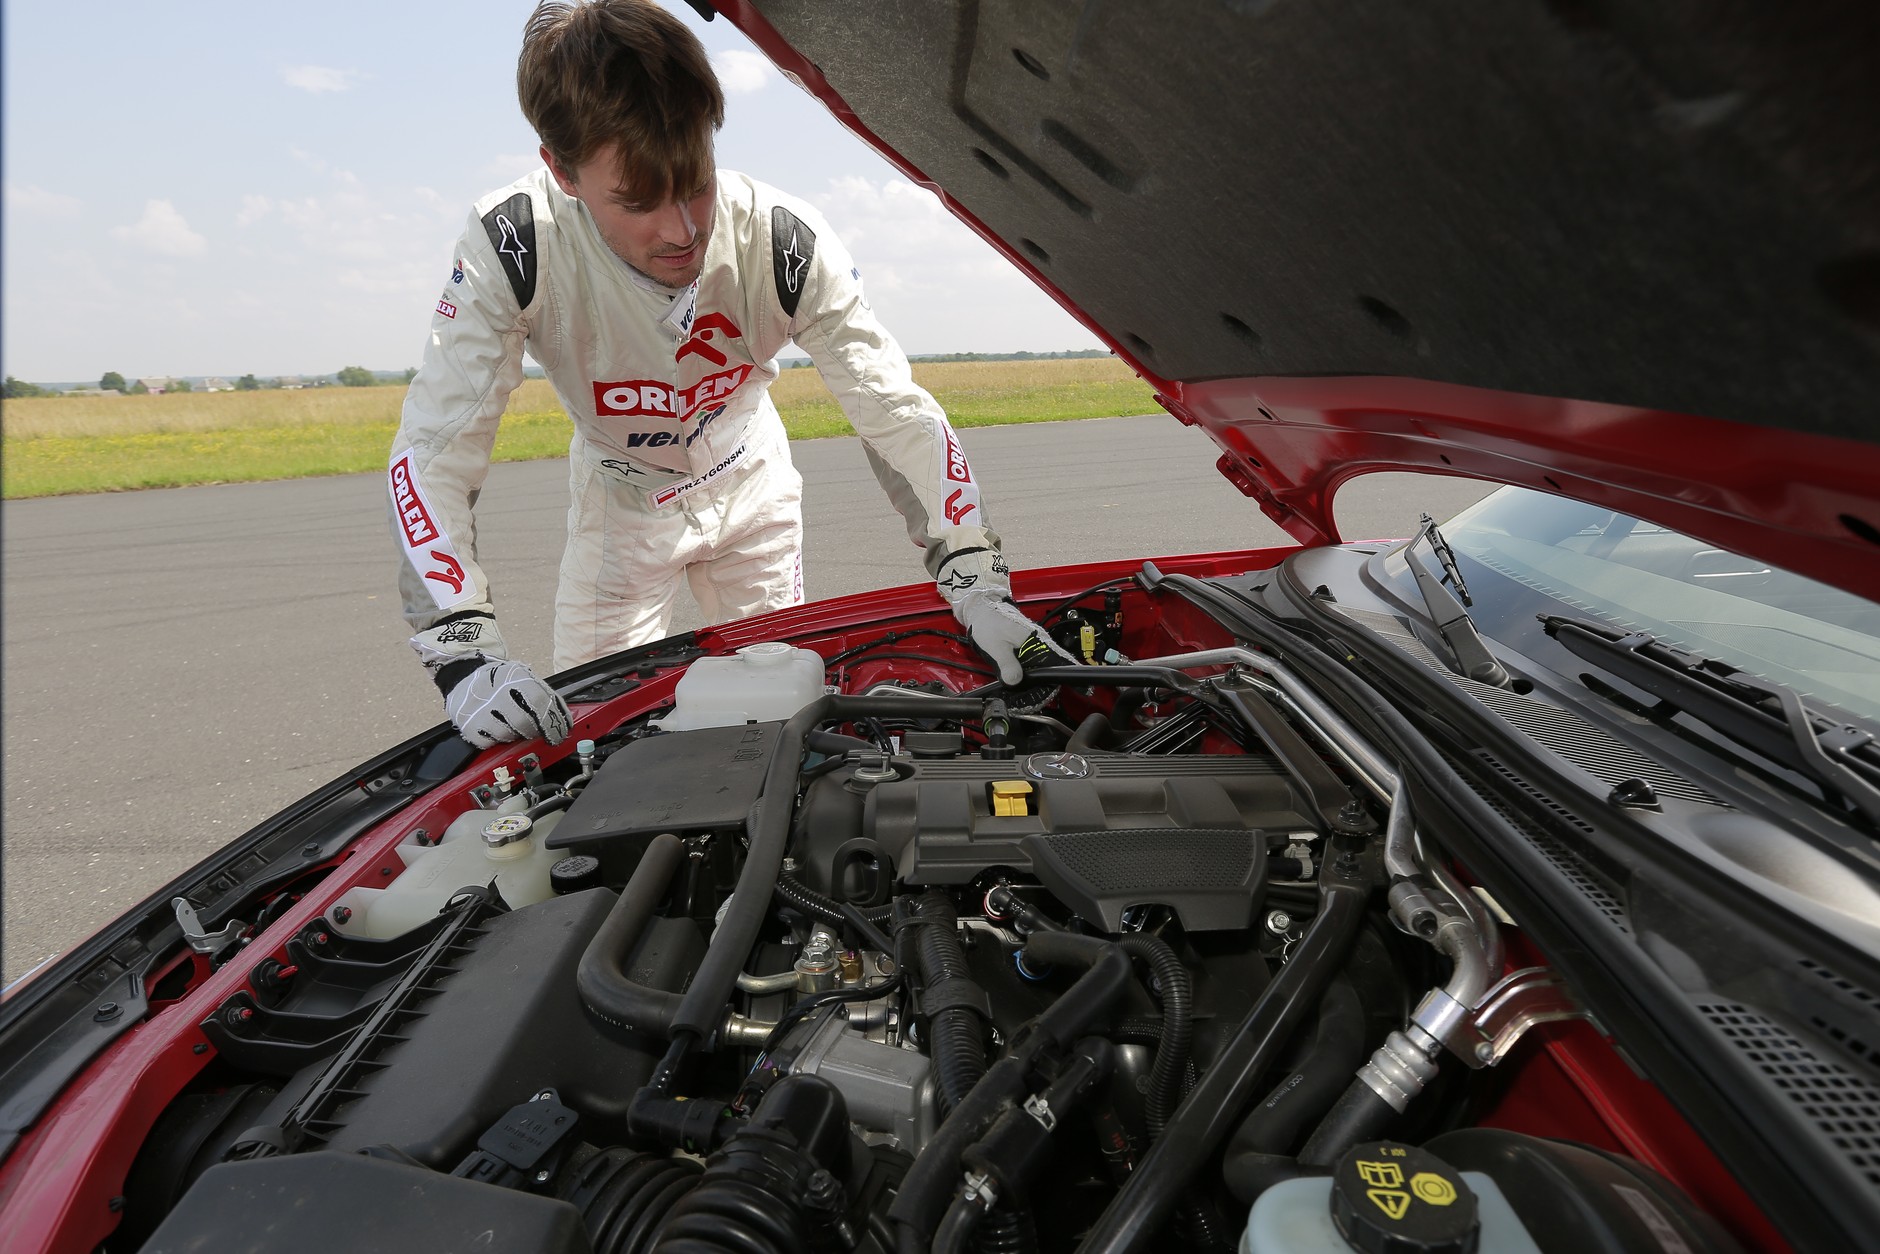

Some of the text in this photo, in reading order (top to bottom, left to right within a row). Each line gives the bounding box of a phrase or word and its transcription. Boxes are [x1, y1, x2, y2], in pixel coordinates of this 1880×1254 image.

[602, 369, 743, 418] ORLEN
[677, 445, 746, 494] PRZYGOŃSKI
[393, 465, 432, 543] ORLEN
